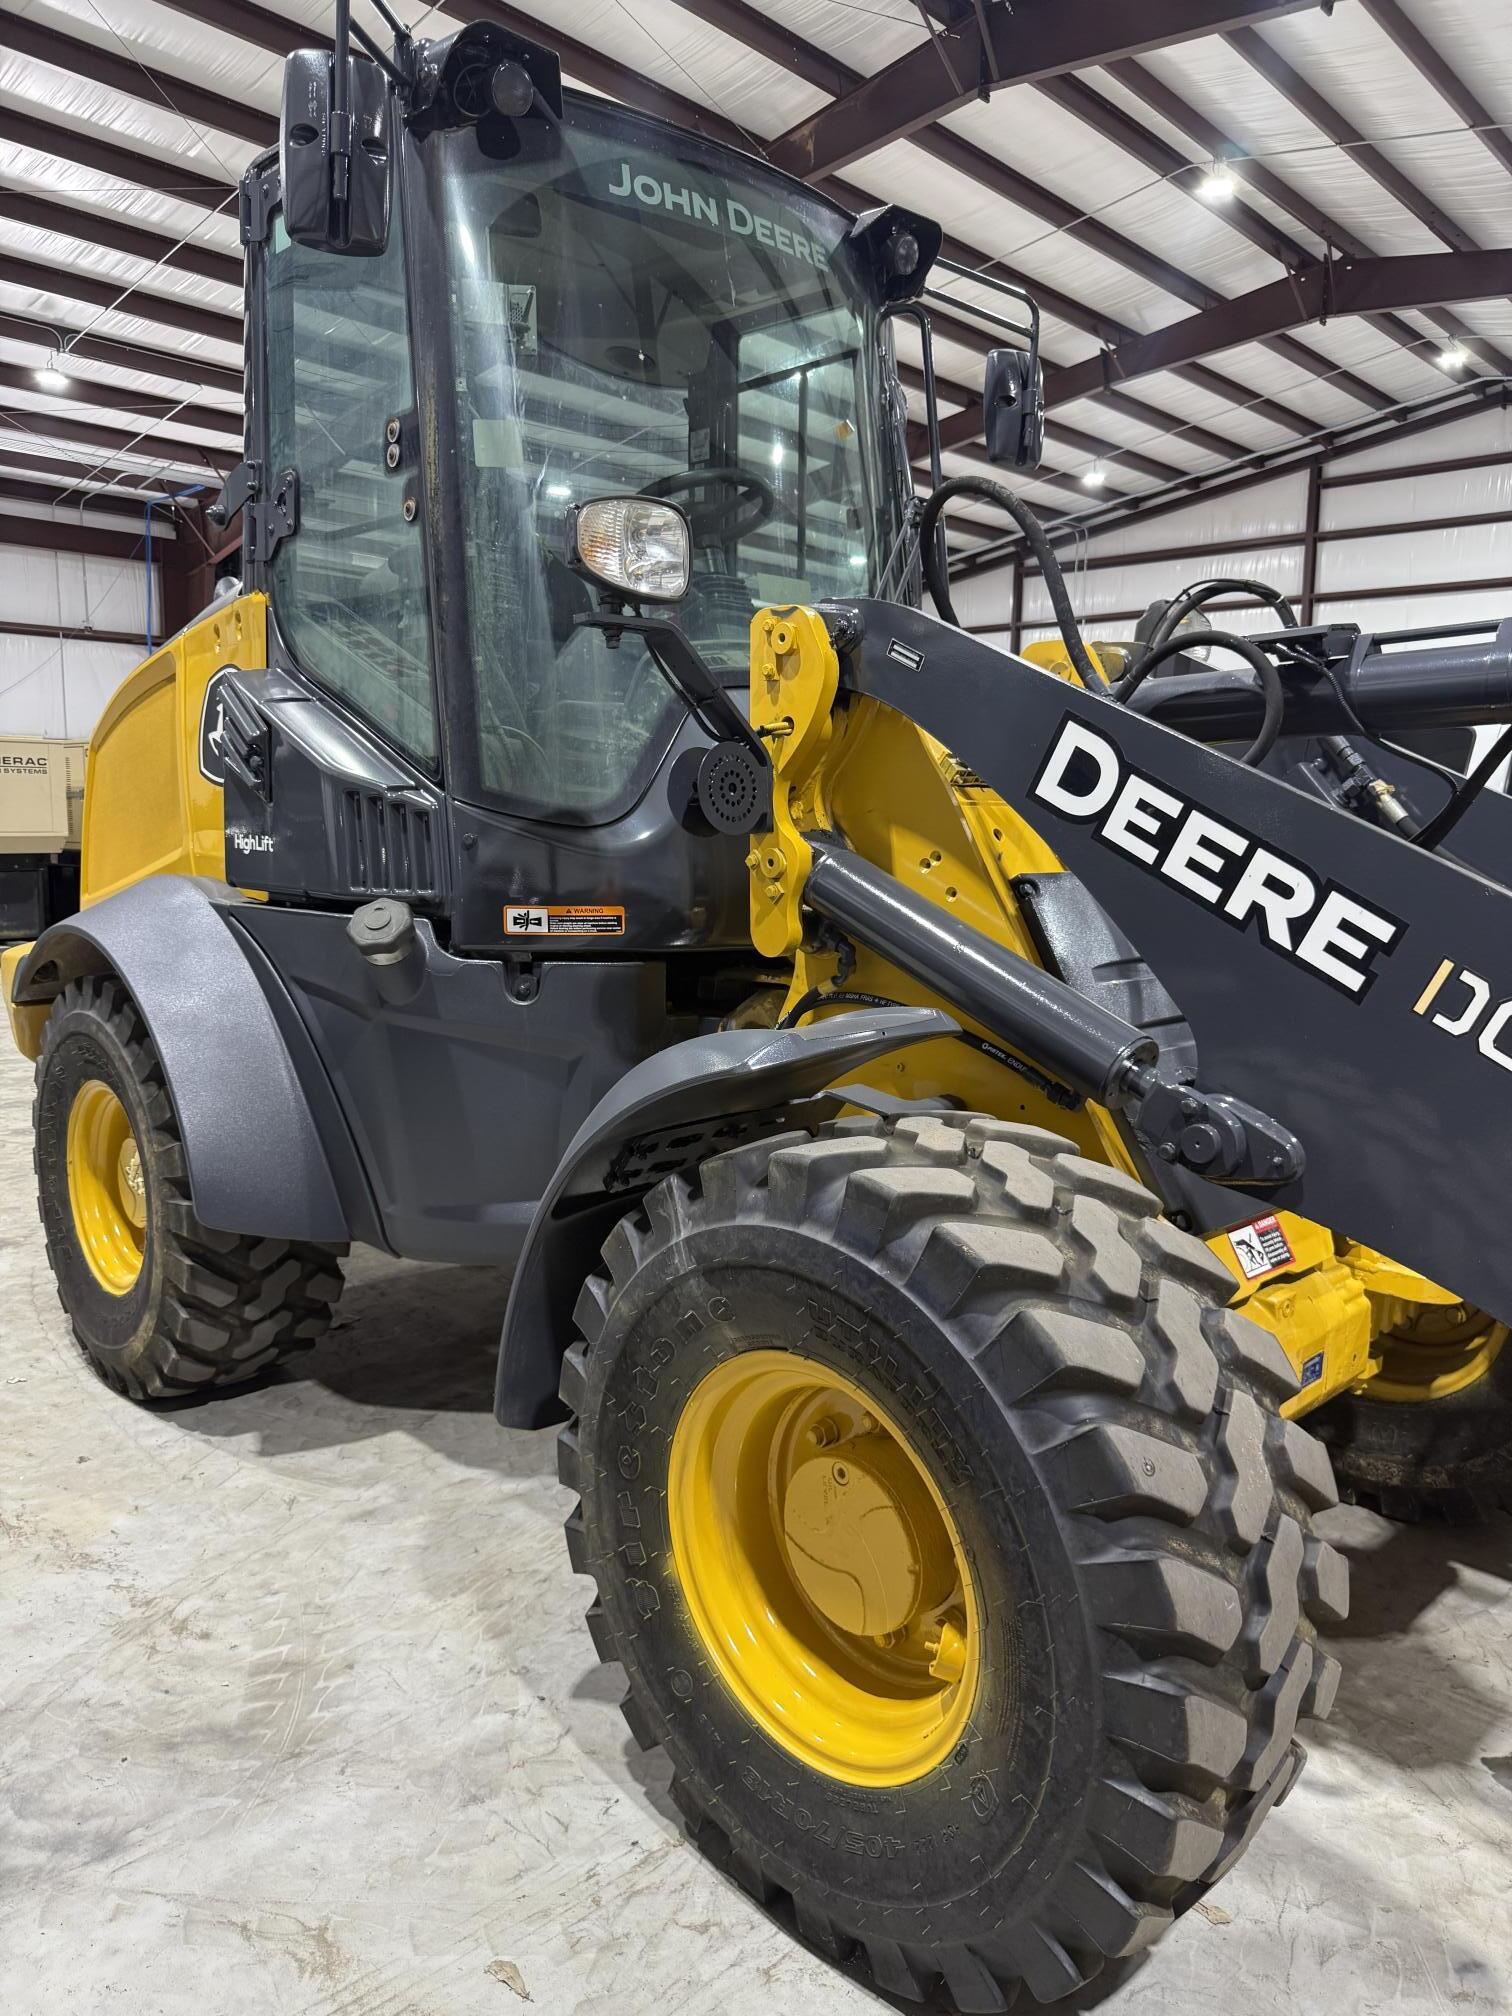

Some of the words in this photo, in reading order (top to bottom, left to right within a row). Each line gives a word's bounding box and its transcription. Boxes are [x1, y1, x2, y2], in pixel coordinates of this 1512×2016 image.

[609, 163, 719, 225] JOHN
[727, 199, 829, 272] DEERE
[3, 767, 48, 775] SYSTEMS
[1034, 719, 1397, 992] DEERE
